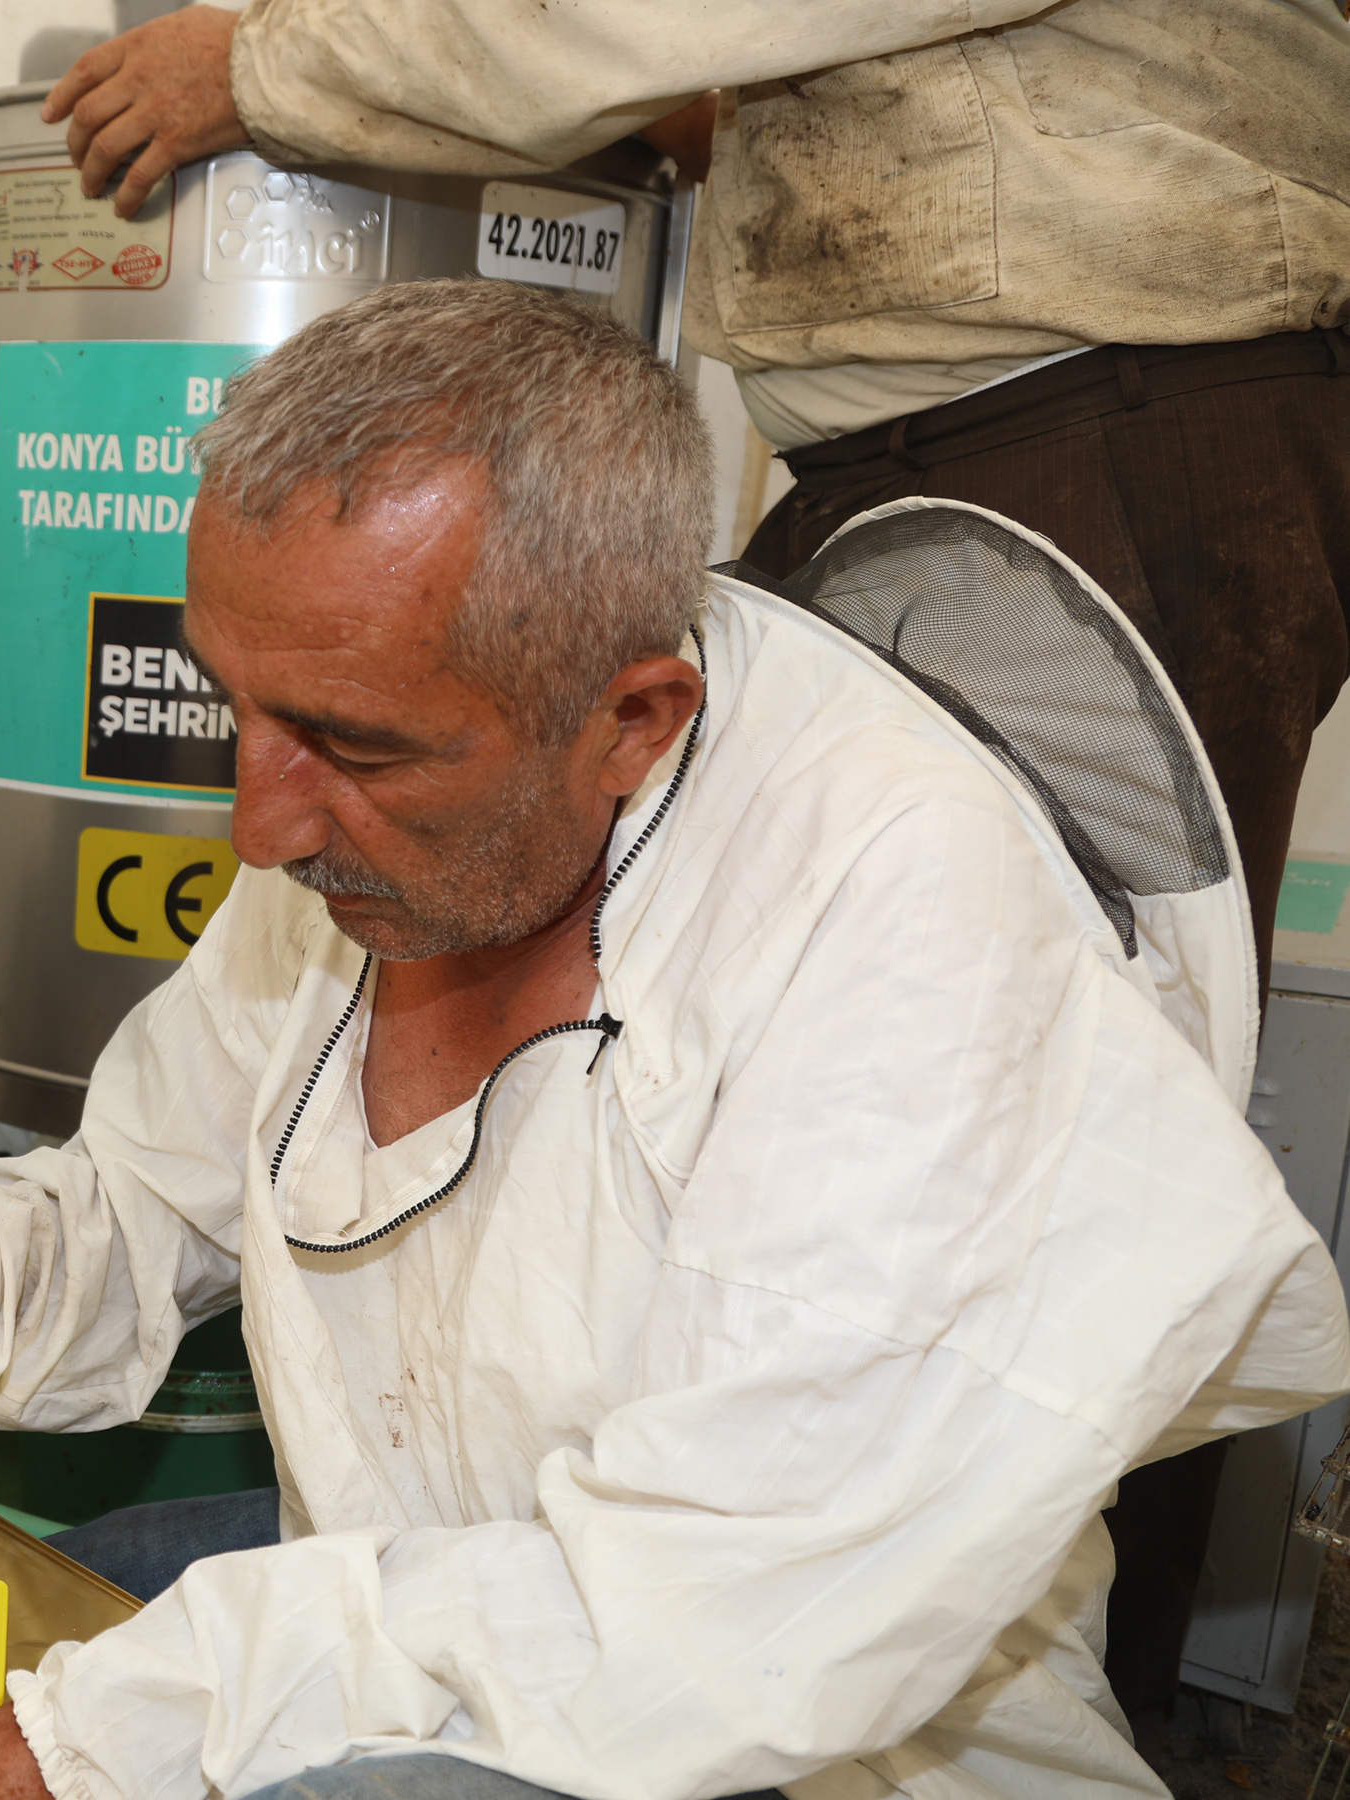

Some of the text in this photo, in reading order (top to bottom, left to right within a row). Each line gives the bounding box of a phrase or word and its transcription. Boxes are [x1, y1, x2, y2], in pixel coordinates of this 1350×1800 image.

[118, 255, 156, 273] TURKEY
[489, 212, 620, 272] 42.2021.87
[18, 432, 124, 472] KONYA
[97, 855, 213, 947] CE
